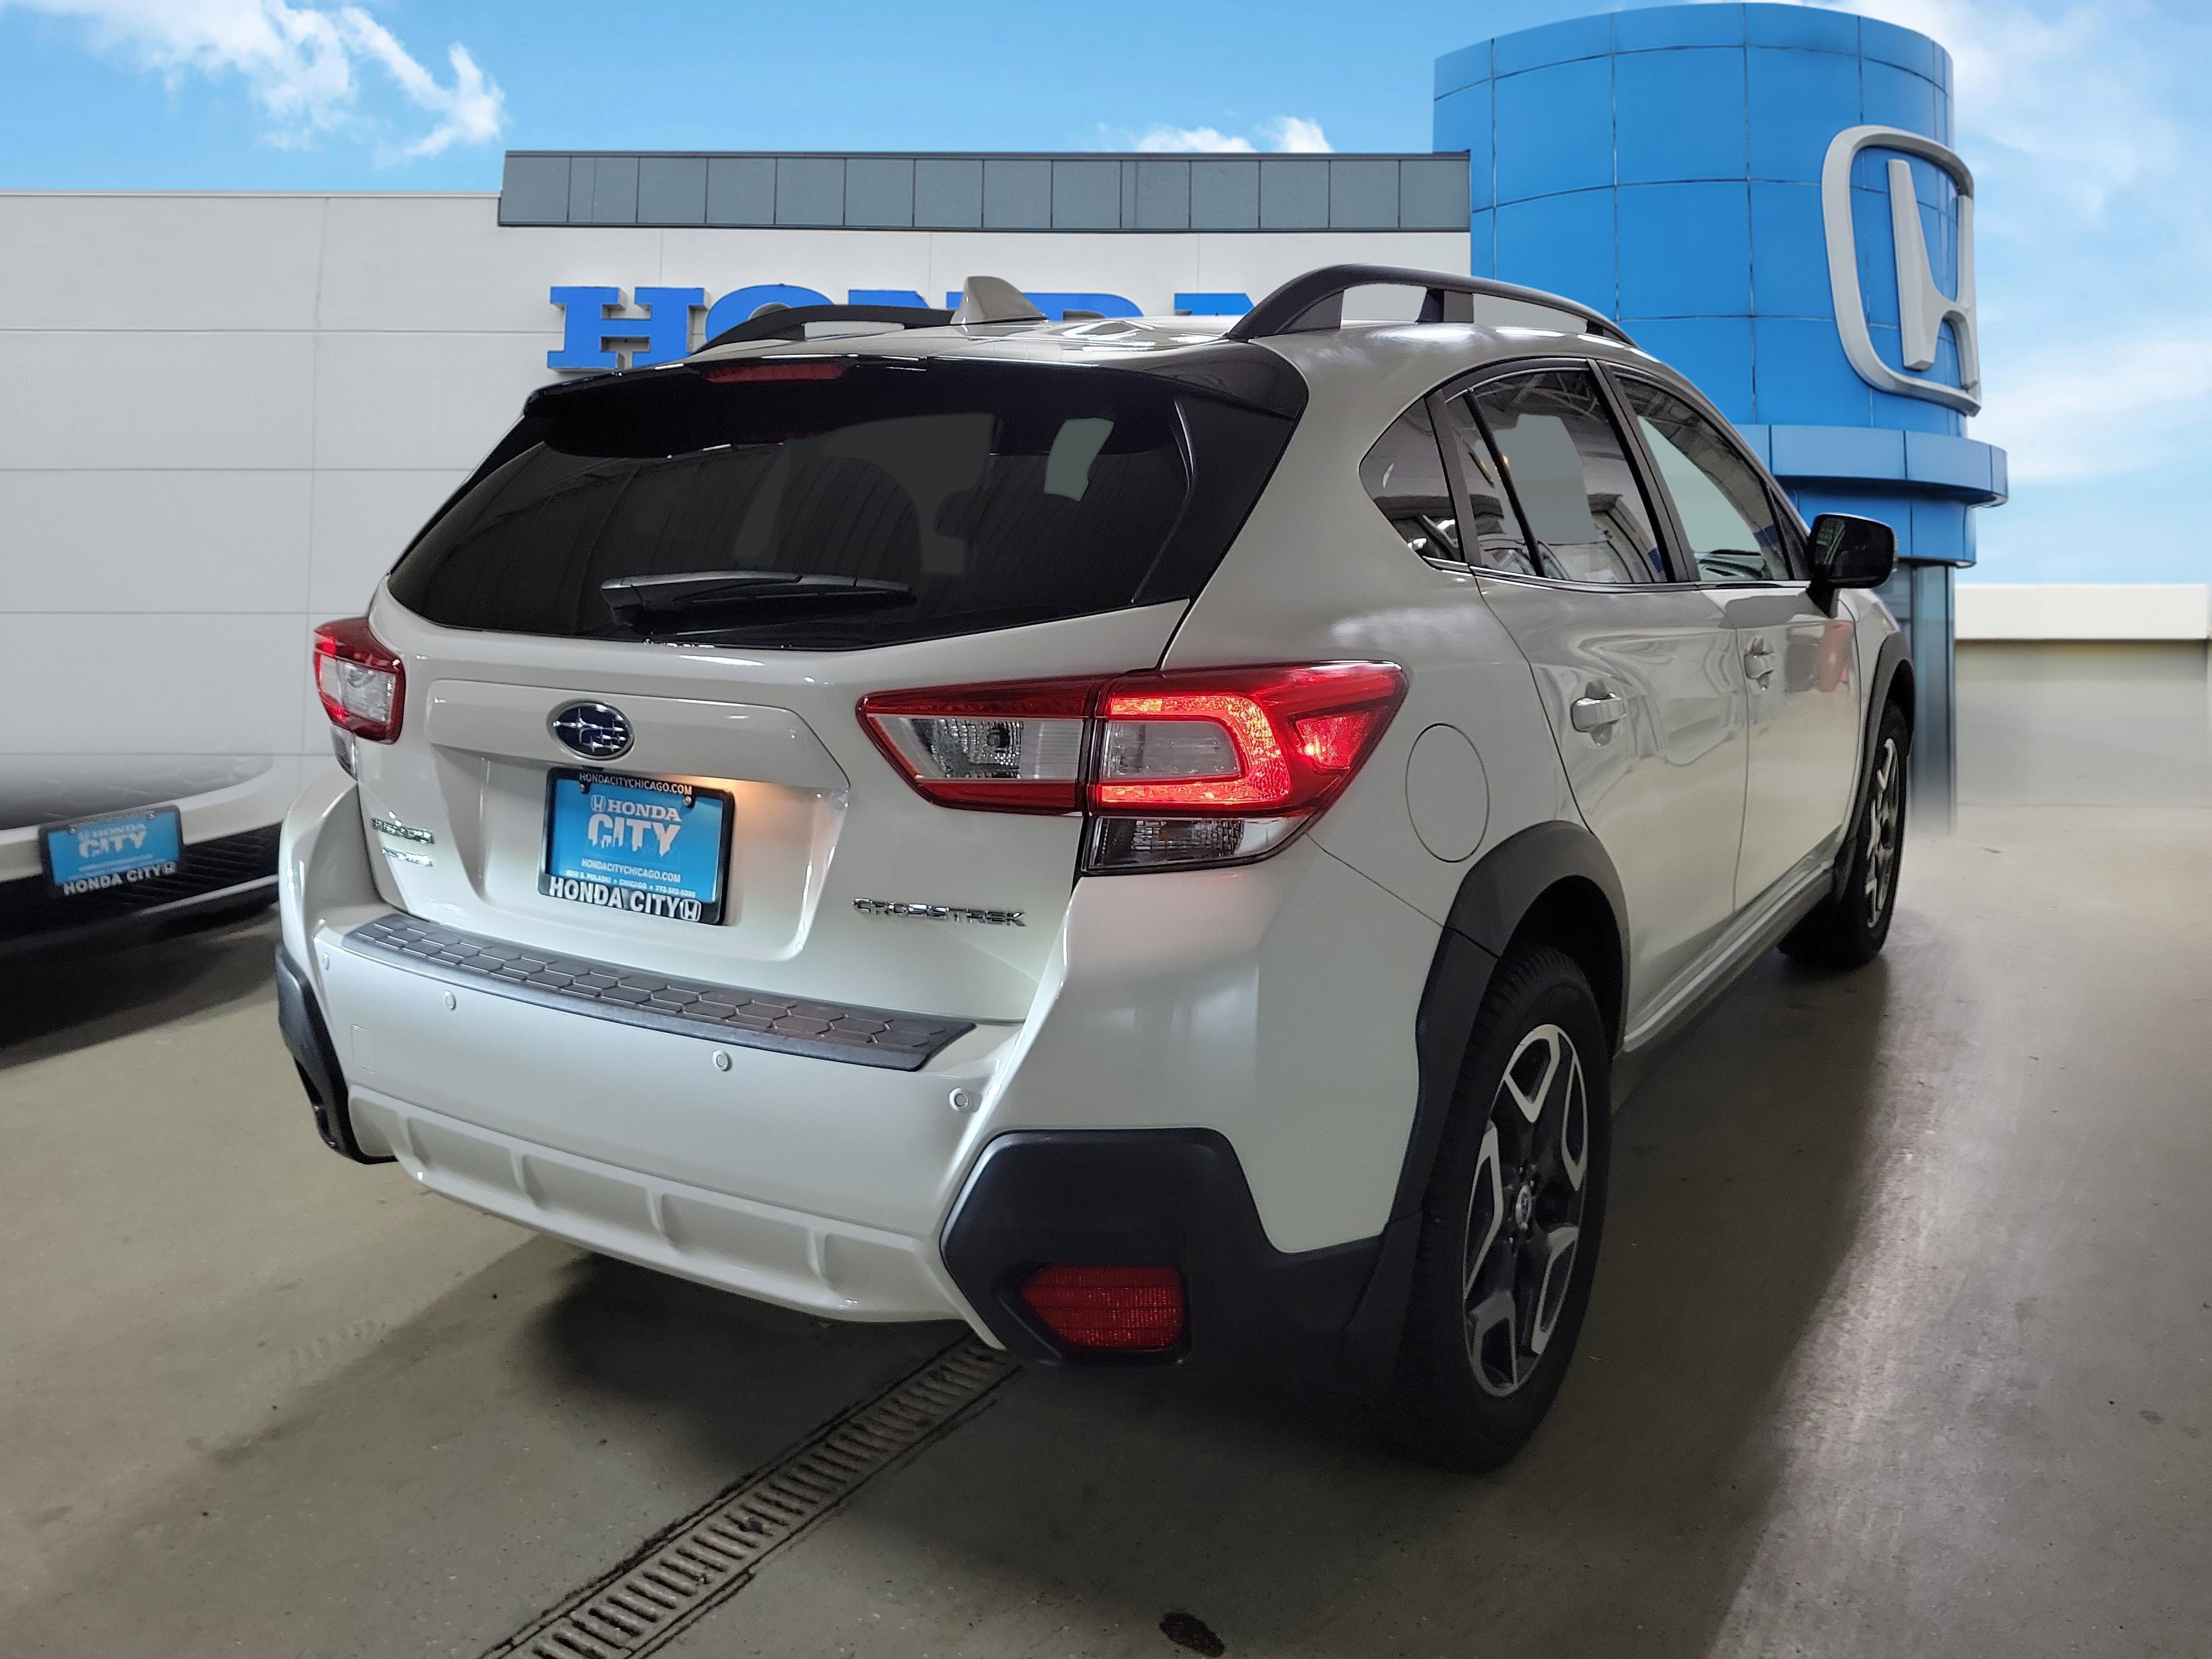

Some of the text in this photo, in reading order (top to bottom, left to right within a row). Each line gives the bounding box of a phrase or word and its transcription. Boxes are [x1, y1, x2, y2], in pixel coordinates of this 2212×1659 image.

[579, 773, 692, 796] HONDACITYCHICAGO.COM
[608, 799, 682, 822] HONDA
[78, 831, 147, 859] CITY
[588, 813, 681, 857] CITY
[63, 874, 122, 896] HONDA
[126, 864, 161, 883] CITY
[581, 858, 681, 883] HONDACITYCHICAGO.COM
[619, 879, 648, 890] CHICAGO
[549, 876, 681, 918] HONDA CITY
[850, 897, 1026, 927] CROSSTREK
